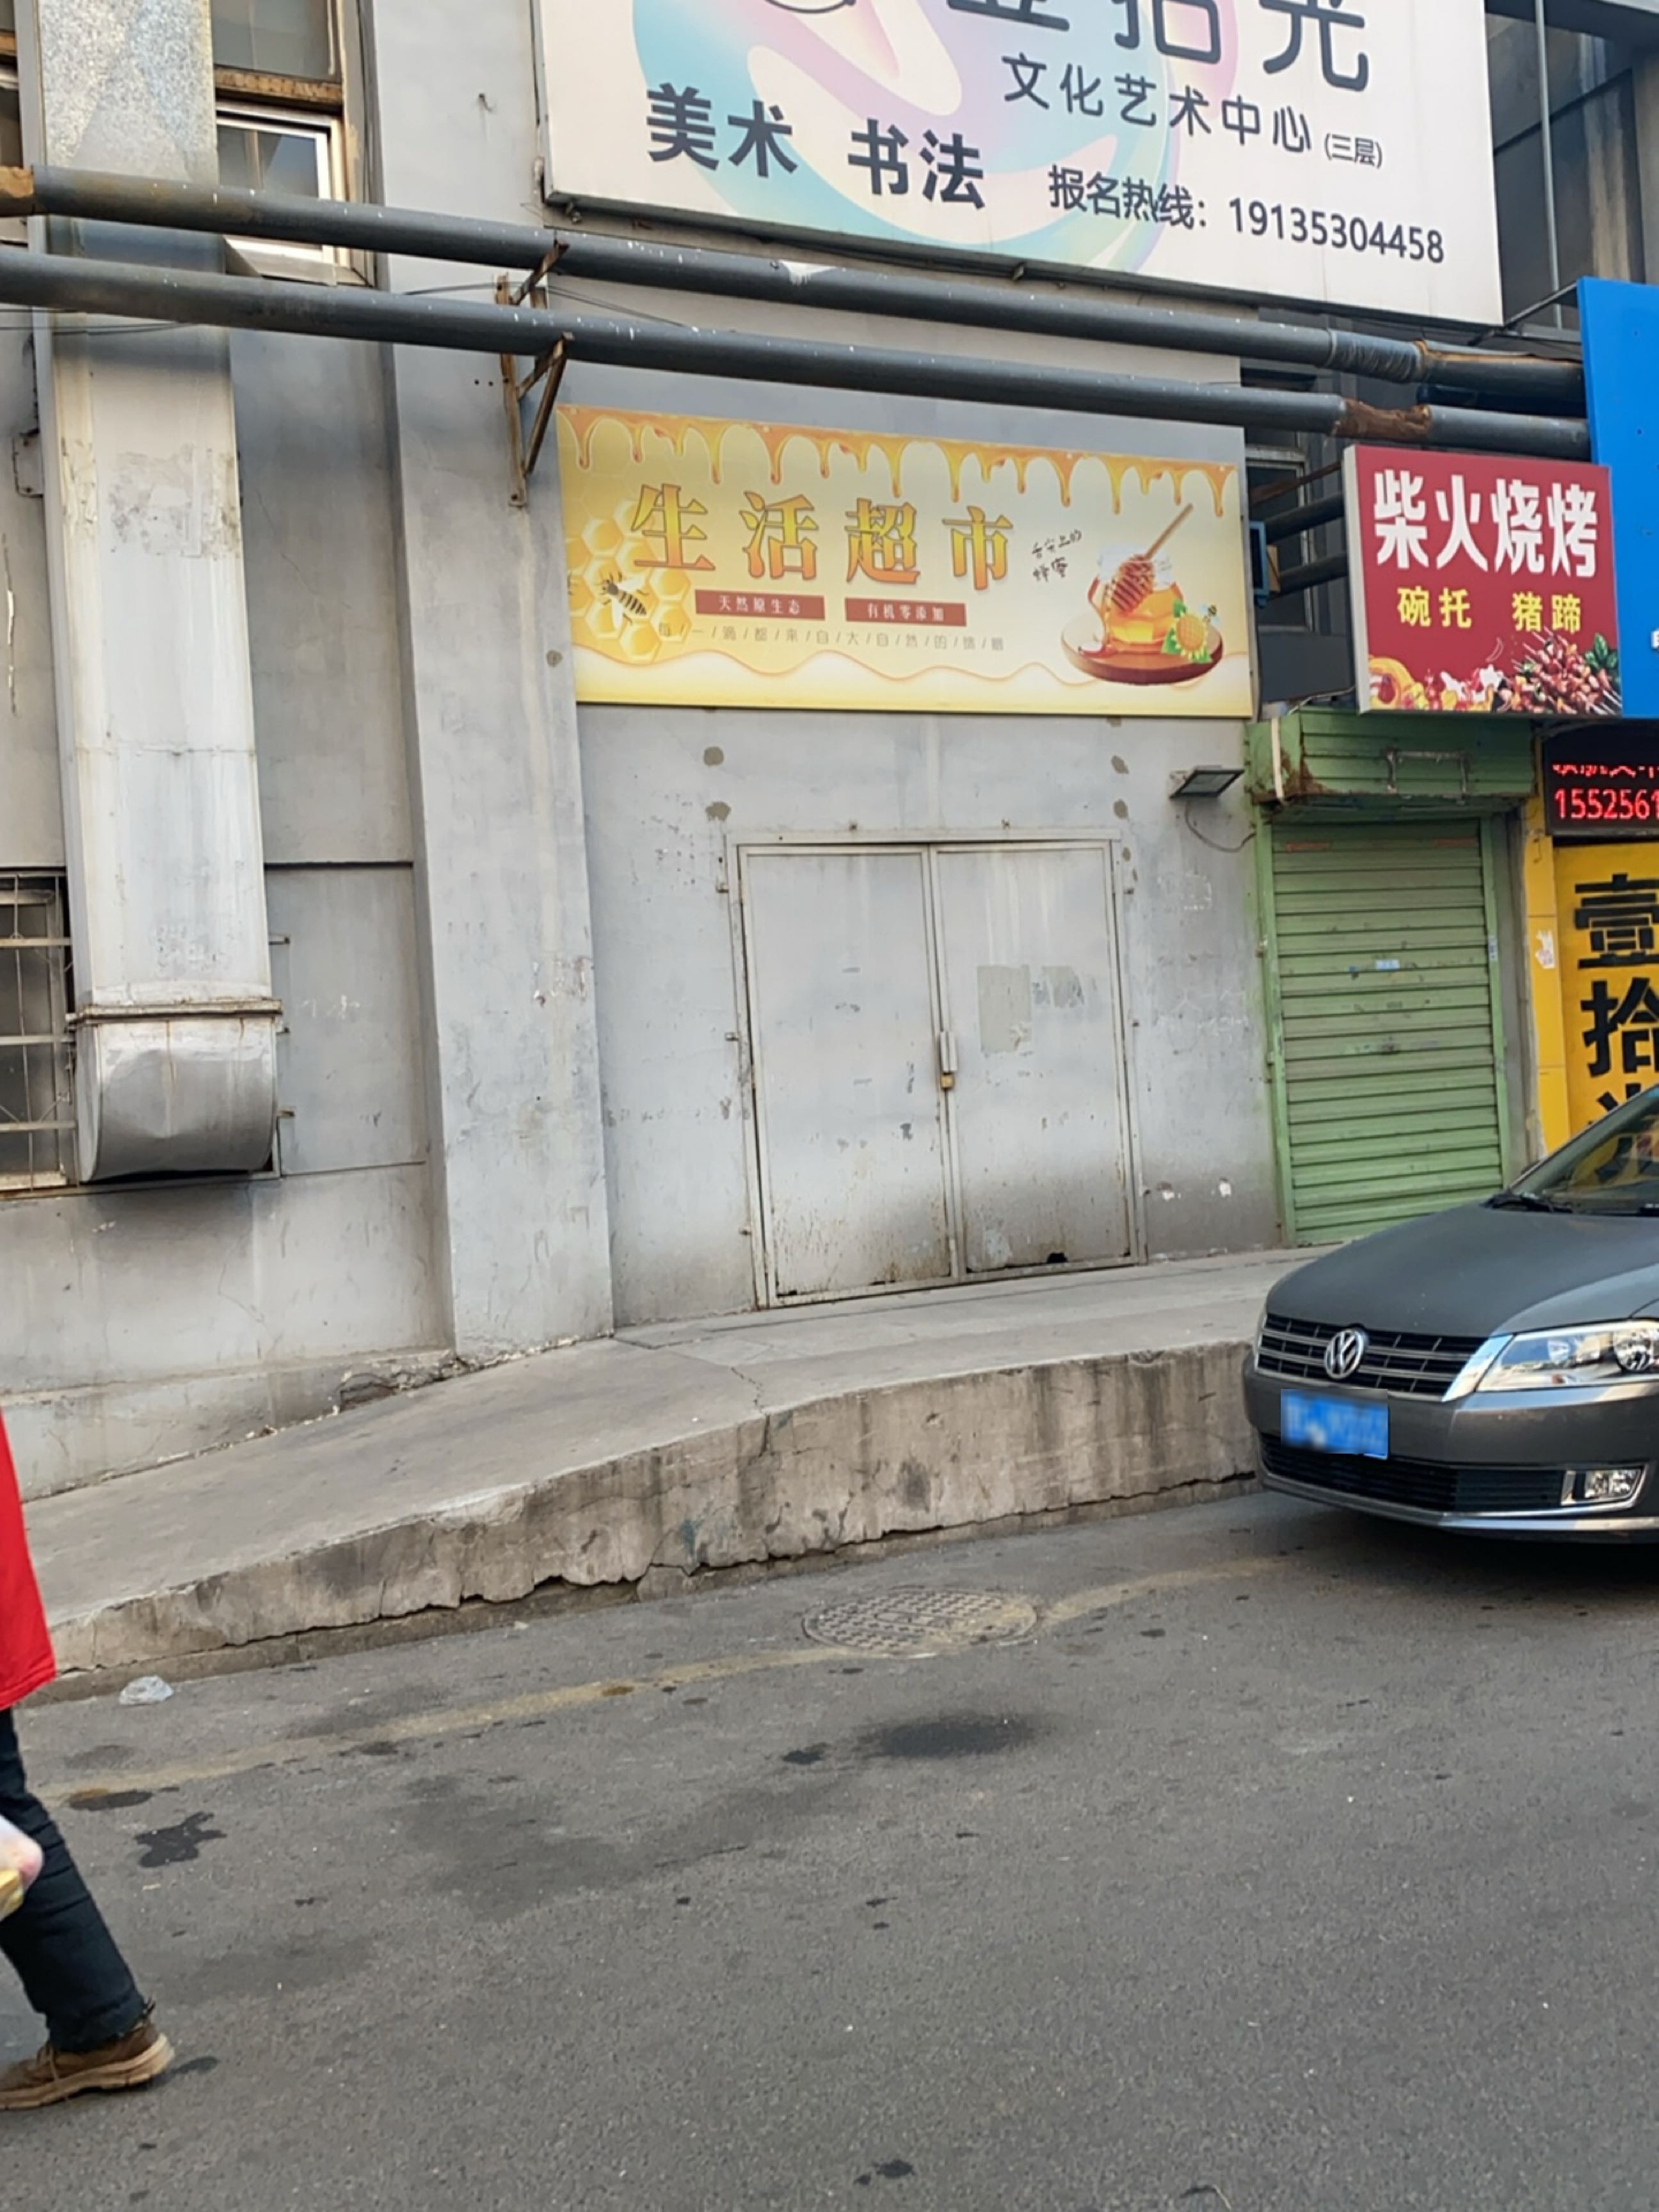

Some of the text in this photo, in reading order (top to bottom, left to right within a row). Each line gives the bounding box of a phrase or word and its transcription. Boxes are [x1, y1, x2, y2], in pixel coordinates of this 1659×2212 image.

[646, 83, 985, 209] 美术 书法
[631, 483, 1013, 590] 生活超市
[1374, 469, 1598, 577] 柴火烧烤
[1397, 586, 1581, 634] 碗托 猪蹄
